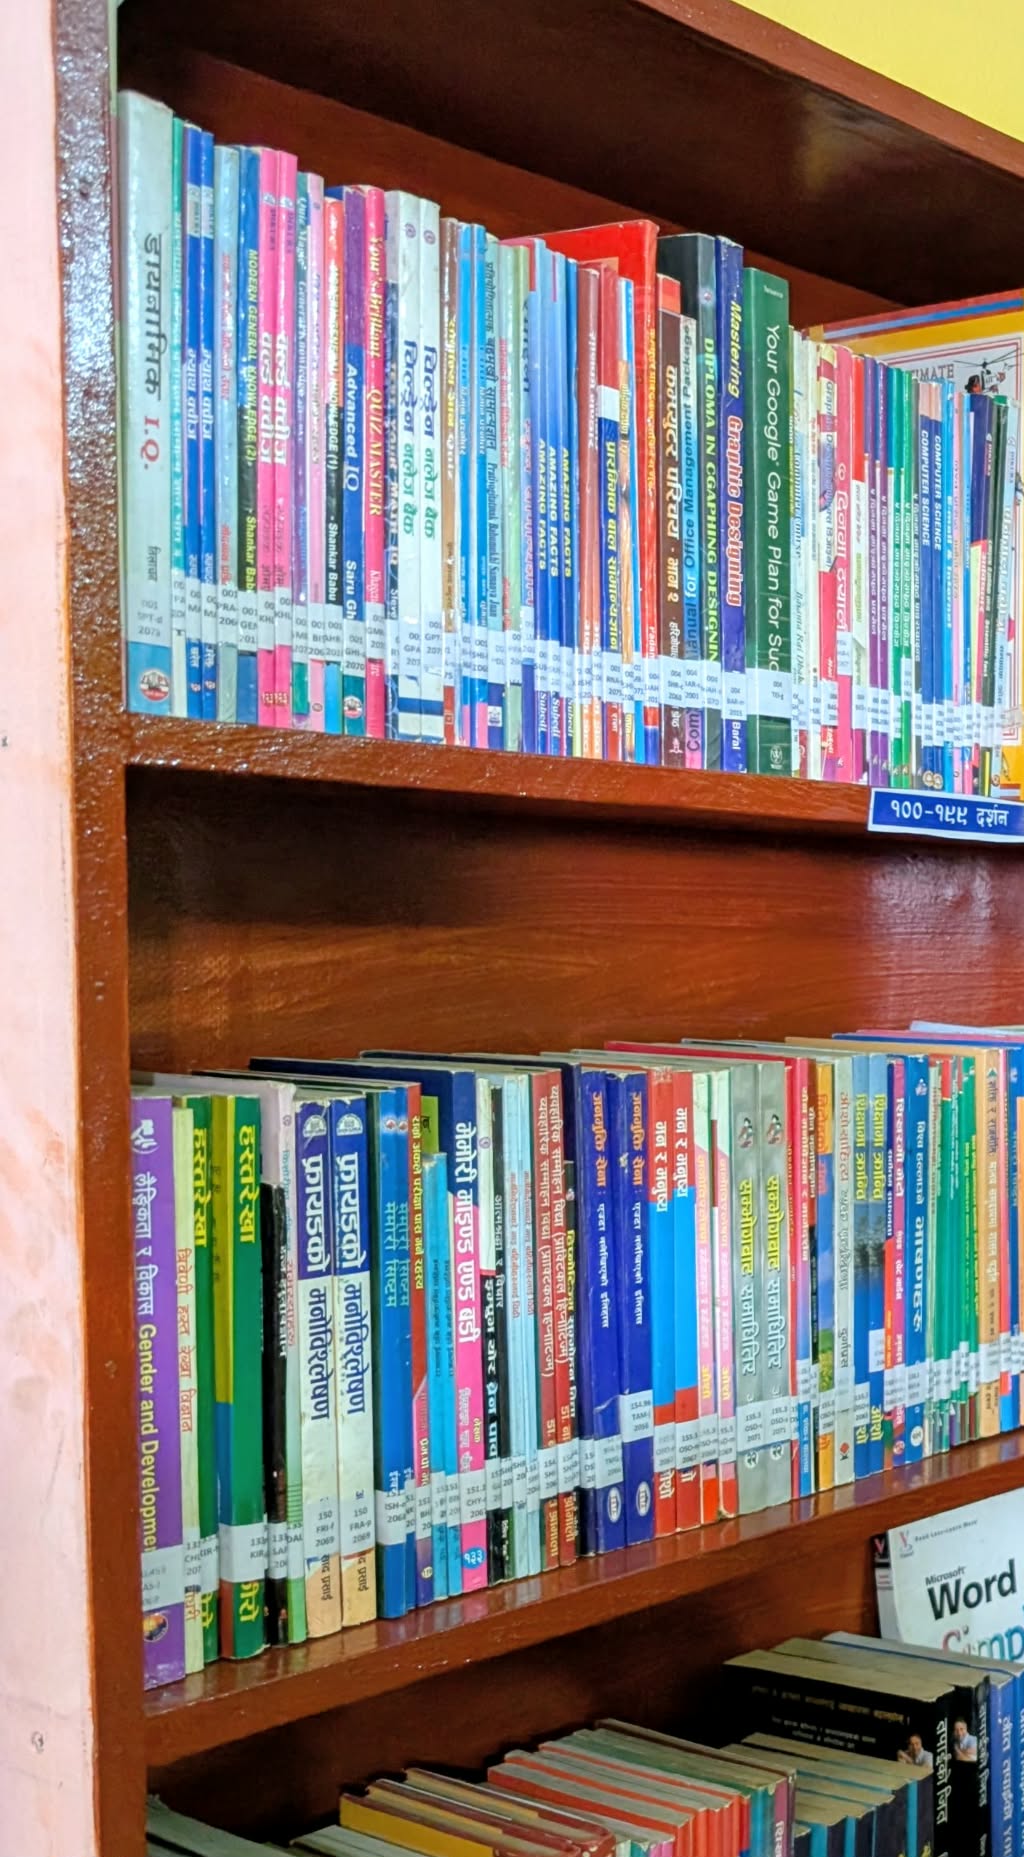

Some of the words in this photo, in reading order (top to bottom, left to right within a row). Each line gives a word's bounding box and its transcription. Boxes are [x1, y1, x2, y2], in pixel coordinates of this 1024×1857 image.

[246, 249, 258, 302] MODERN
[246, 305, 258, 361] GENERAL
[727, 300, 742, 398] Mastering
[766, 324, 780, 372] Your
[681, 325, 692, 402] Package
[704, 338, 716, 428] DIPLOMA
[245, 366, 257, 441] KNOWLEDGE
[326, 378, 339, 452] KNOWLEDGE
[345, 363, 358, 458] Advanced
[368, 389, 382, 434] QUIZ
[762, 378, 782, 462] Google
[682, 402, 696, 512] Management
[704, 434, 717, 456] IN
[726, 416, 742, 498] Graphic
[920, 430, 929, 494] COMPUTER
[933, 435, 942, 500] COMPUTER
[368, 440, 382, 516] MASTER
[538, 438, 546, 514] AMAZING
[548, 446, 558, 522] AMAZING
[562, 448, 570, 522] AMAZING
[766, 472, 782, 539] Game
[920, 498, 930, 546] SCIENCE
[933, 502, 942, 551] SCIENCE
[244, 516, 256, 564] Shankar
[326, 523, 338, 570] Shankar
[538, 520, 546, 570] FACTS
[550, 527, 558, 577] FACTS
[564, 528, 572, 578] FACTS
[683, 520, 696, 569] Office
[726, 502, 742, 606] Designing
[344, 560, 356, 595] Saru
[684, 576, 698, 598] for
[766, 546, 782, 590] Plan
[706, 571, 718, 662] DESIGNIN
[766, 596, 782, 626] for
[766, 634, 782, 672] Suc
[730, 722, 740, 750] Baral
[976, 804, 1009, 828] दर्शन
[654, 1121, 668, 1147] मन
[674, 1108, 688, 1134] मन
[454, 1122, 476, 1183] मेमोरी
[672, 1153, 688, 1198] मनुष्य
[238, 1125, 260, 1243] हस्तरेखा
[335, 1152, 367, 1268] फ्रायडको
[651, 1168, 668, 1212] मनुष्य
[301, 1154, 330, 1272] फ्रायडको
[455, 1188, 474, 1254] माइण्ड
[136, 1264, 158, 1315] विकास
[457, 1260, 474, 1300] एण्ड
[341, 1282, 369, 1414] मनोविश्लेषण
[457, 1308, 480, 1342] बडी
[138, 1324, 158, 1392] Gender
[308, 1288, 334, 1422] मनोविश्लेषण
[139, 1400, 158, 1435] and
[925, 1566, 967, 1586] Microsoft
[927, 1558, 1016, 1621] Word
